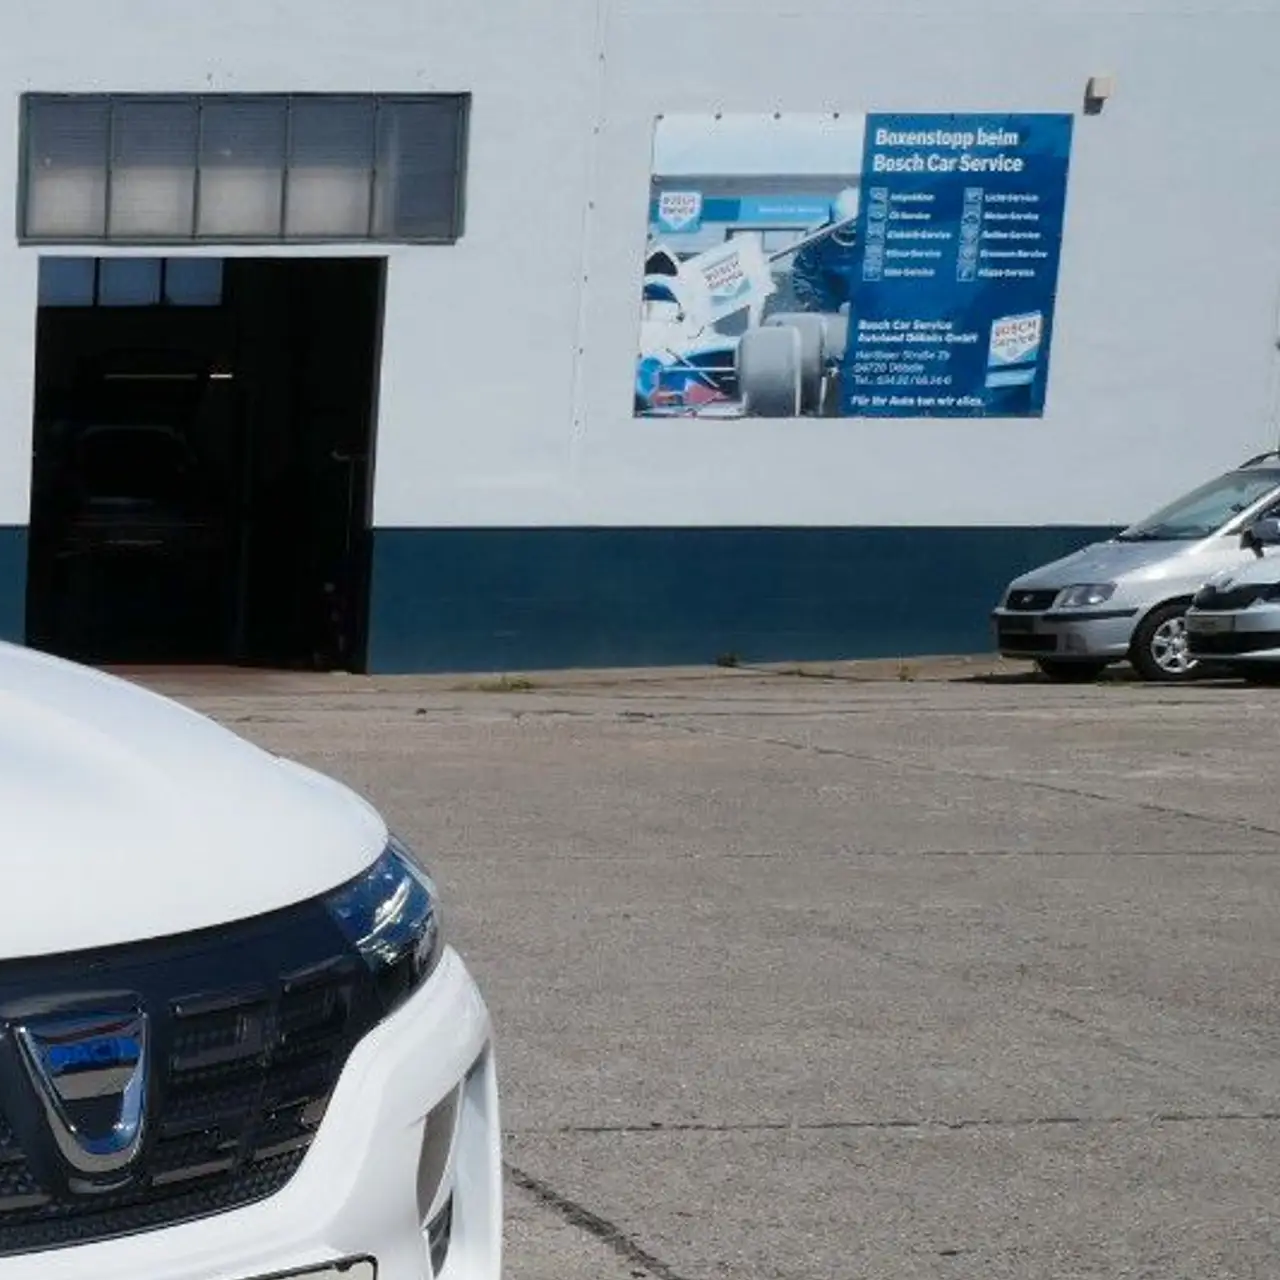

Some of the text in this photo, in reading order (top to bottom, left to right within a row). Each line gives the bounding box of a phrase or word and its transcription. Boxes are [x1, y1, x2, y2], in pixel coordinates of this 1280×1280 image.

[875, 127, 1019, 151] Boxenstopp beim
[873, 153, 1024, 172] Bosch Car Service
